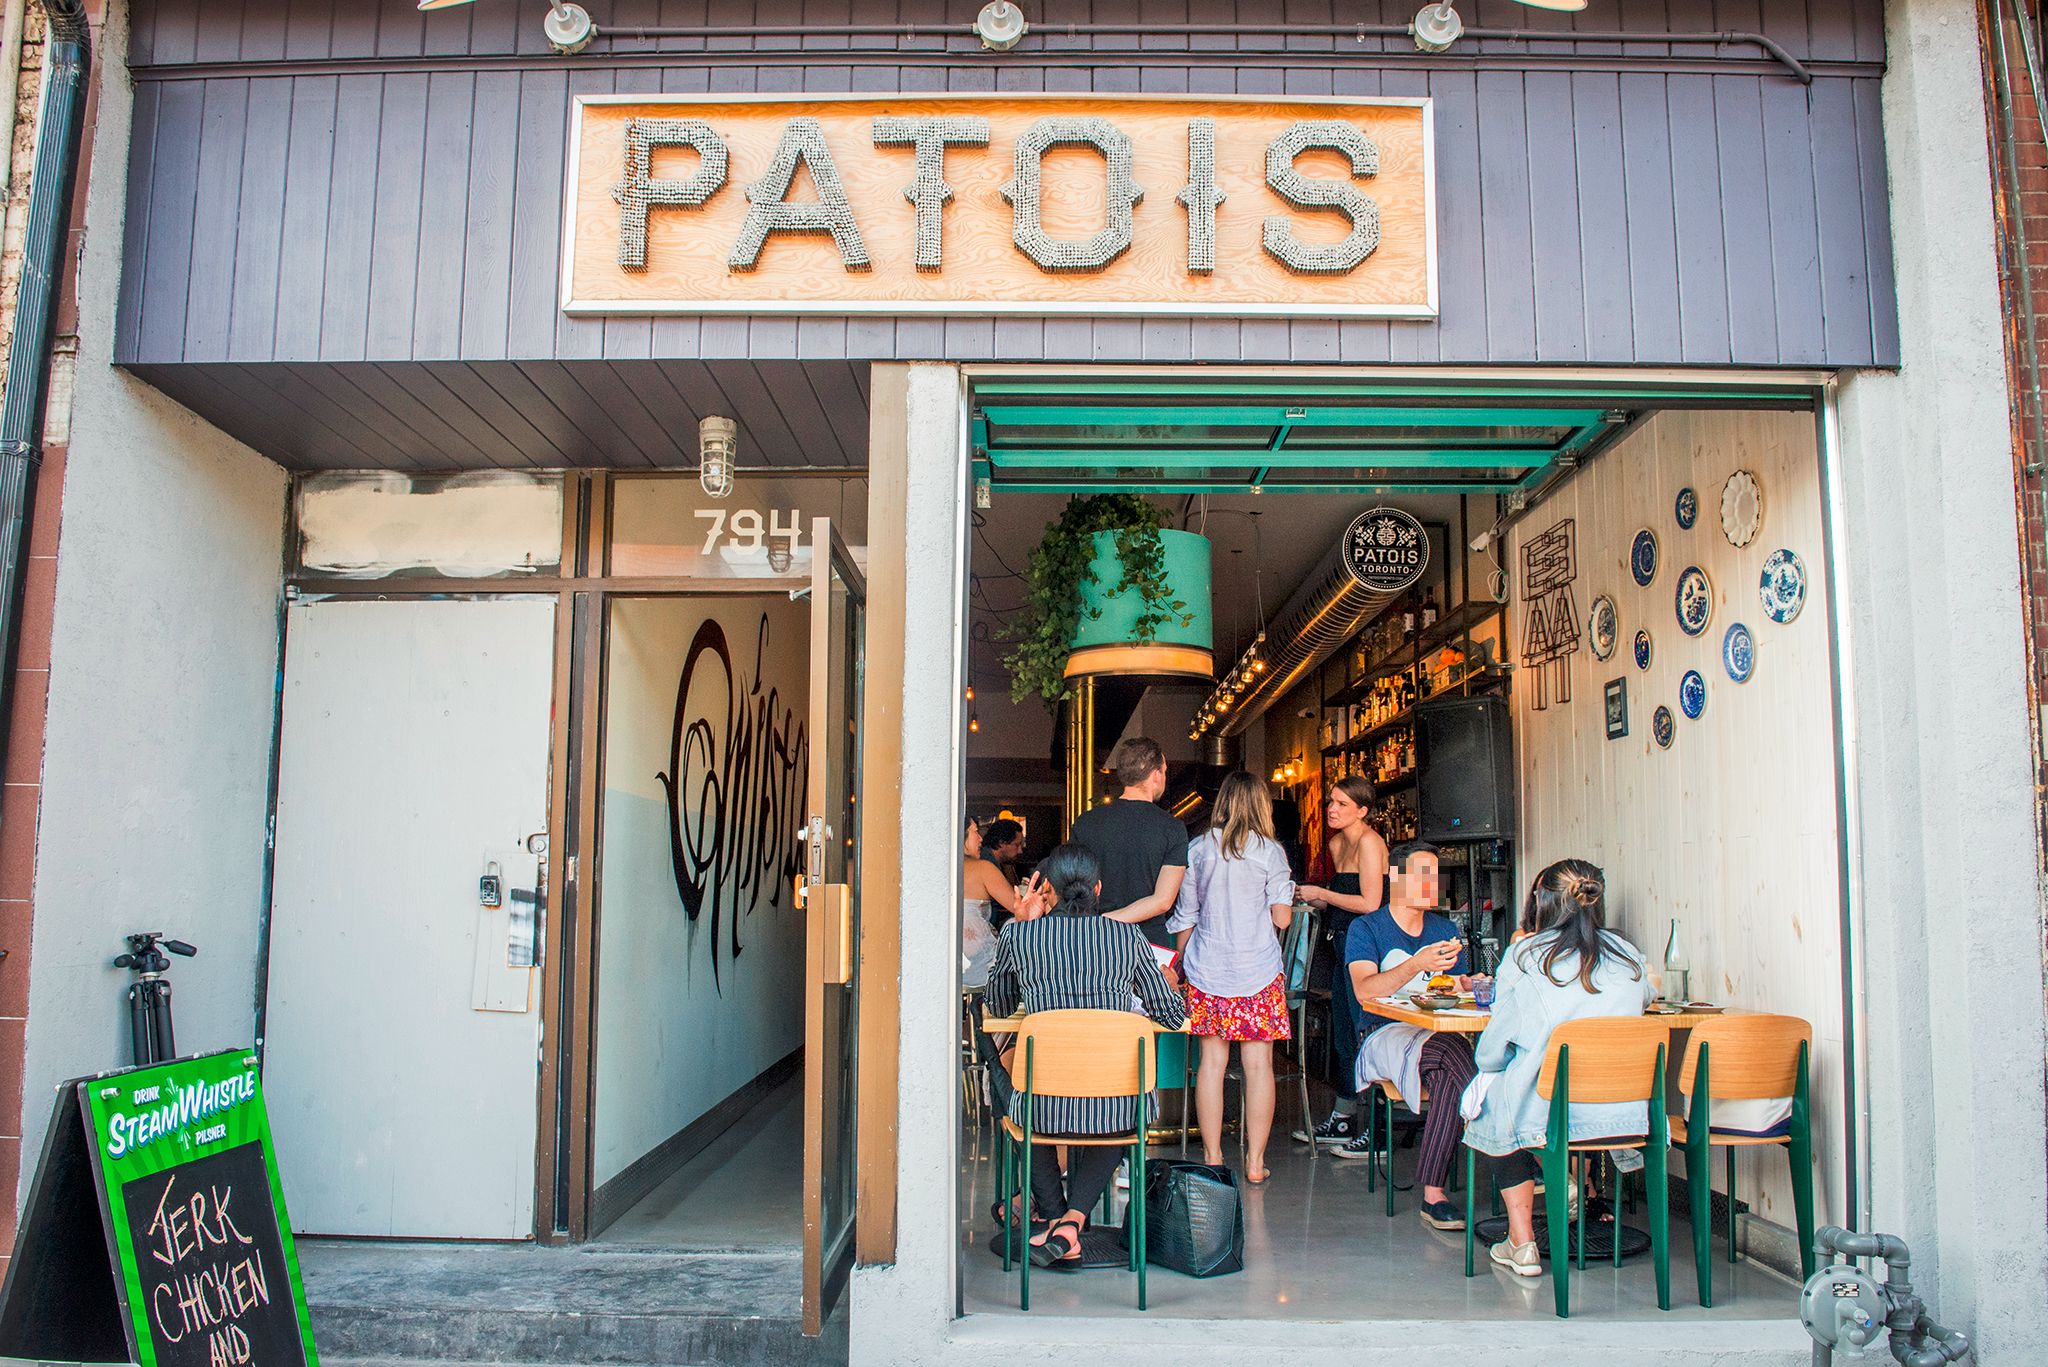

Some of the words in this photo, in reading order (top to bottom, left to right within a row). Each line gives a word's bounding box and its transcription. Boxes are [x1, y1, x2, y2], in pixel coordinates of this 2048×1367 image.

[612, 115, 1381, 275] PATOIS
[694, 508, 801, 556] 794
[1354, 548, 1419, 564] PATOIS
[1361, 564, 1410, 575] TORONTO
[134, 1086, 160, 1106] DRINK
[195, 1123, 227, 1146] PILSNER
[147, 1174, 253, 1266] JERK
[152, 1249, 270, 1343] CHICKEN
[209, 1323, 251, 1367] AND
